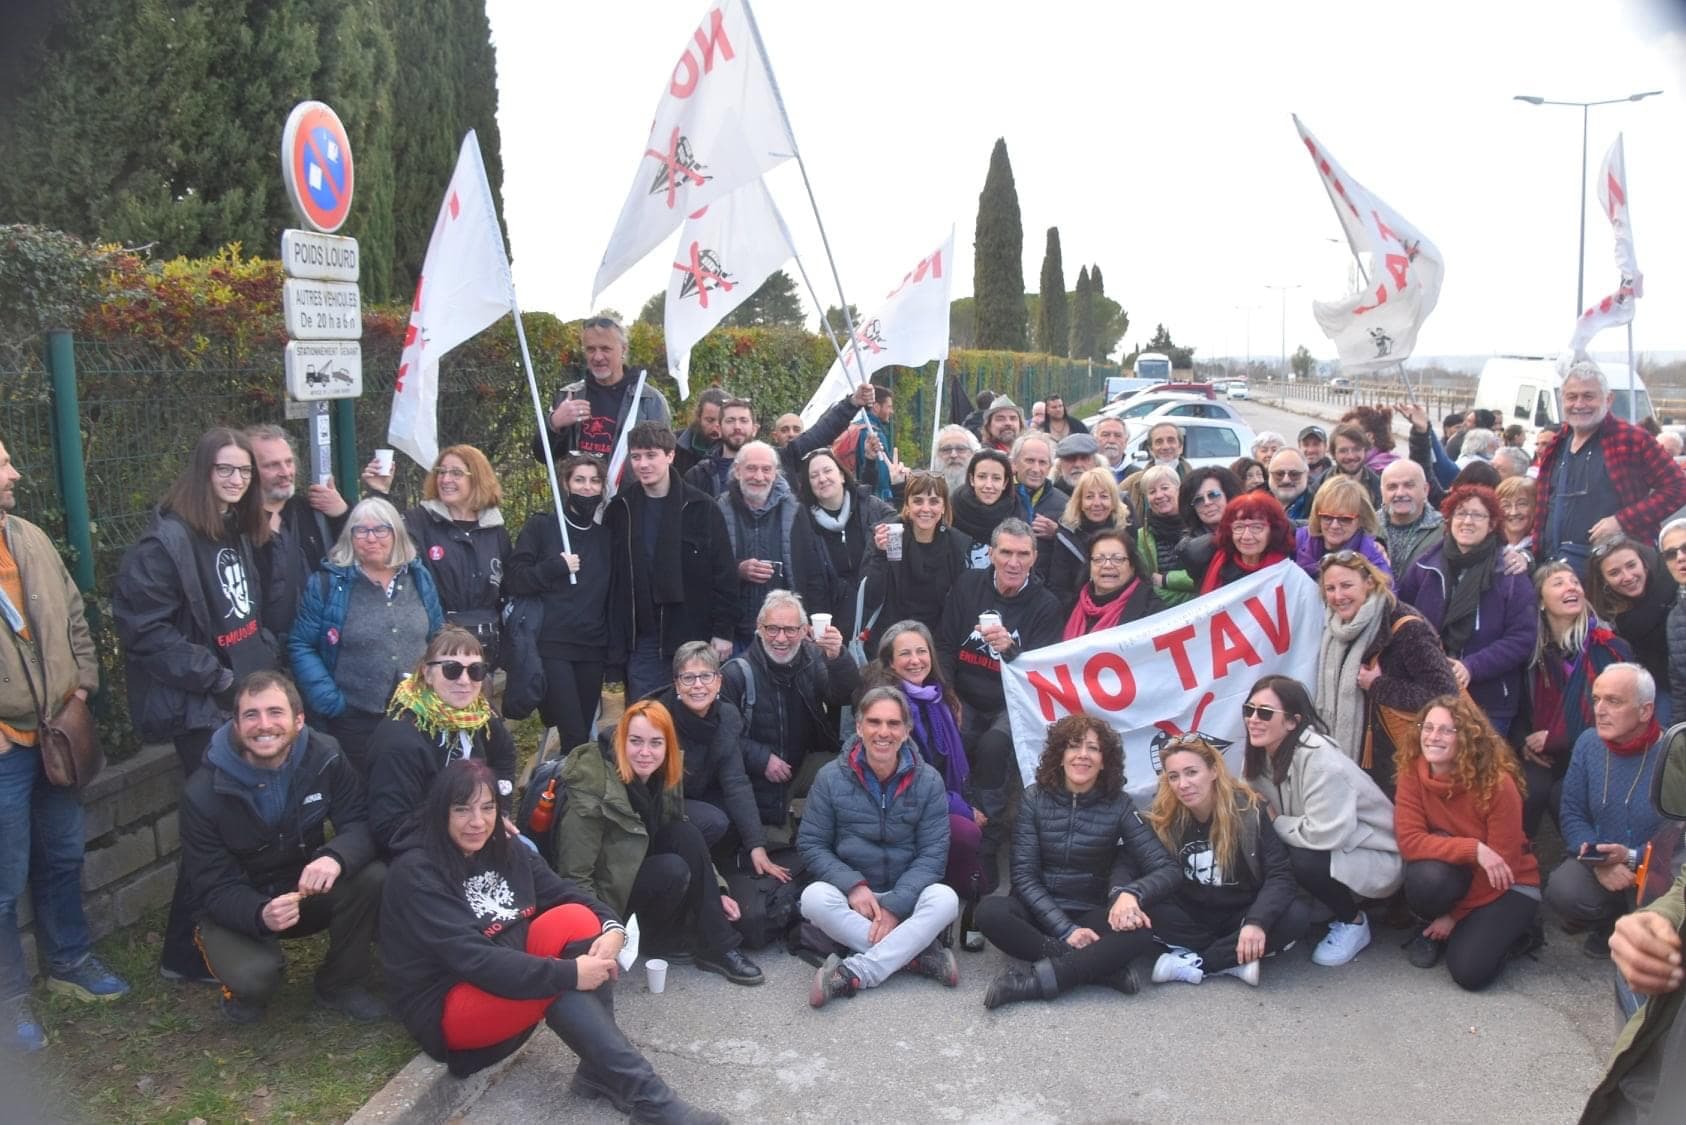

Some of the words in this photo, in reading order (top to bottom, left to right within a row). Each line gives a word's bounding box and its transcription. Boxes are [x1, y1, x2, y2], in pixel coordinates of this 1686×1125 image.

[295, 242, 324, 265] POIDS
[325, 247, 356, 269] LOURD
[296, 289, 322, 306] AUTRES
[301, 312, 313, 328] De
[317, 313, 328, 328] 20
[1027, 652, 1136, 721] NO
[1152, 584, 1292, 692] TAV
[484, 923, 503, 938] NO
